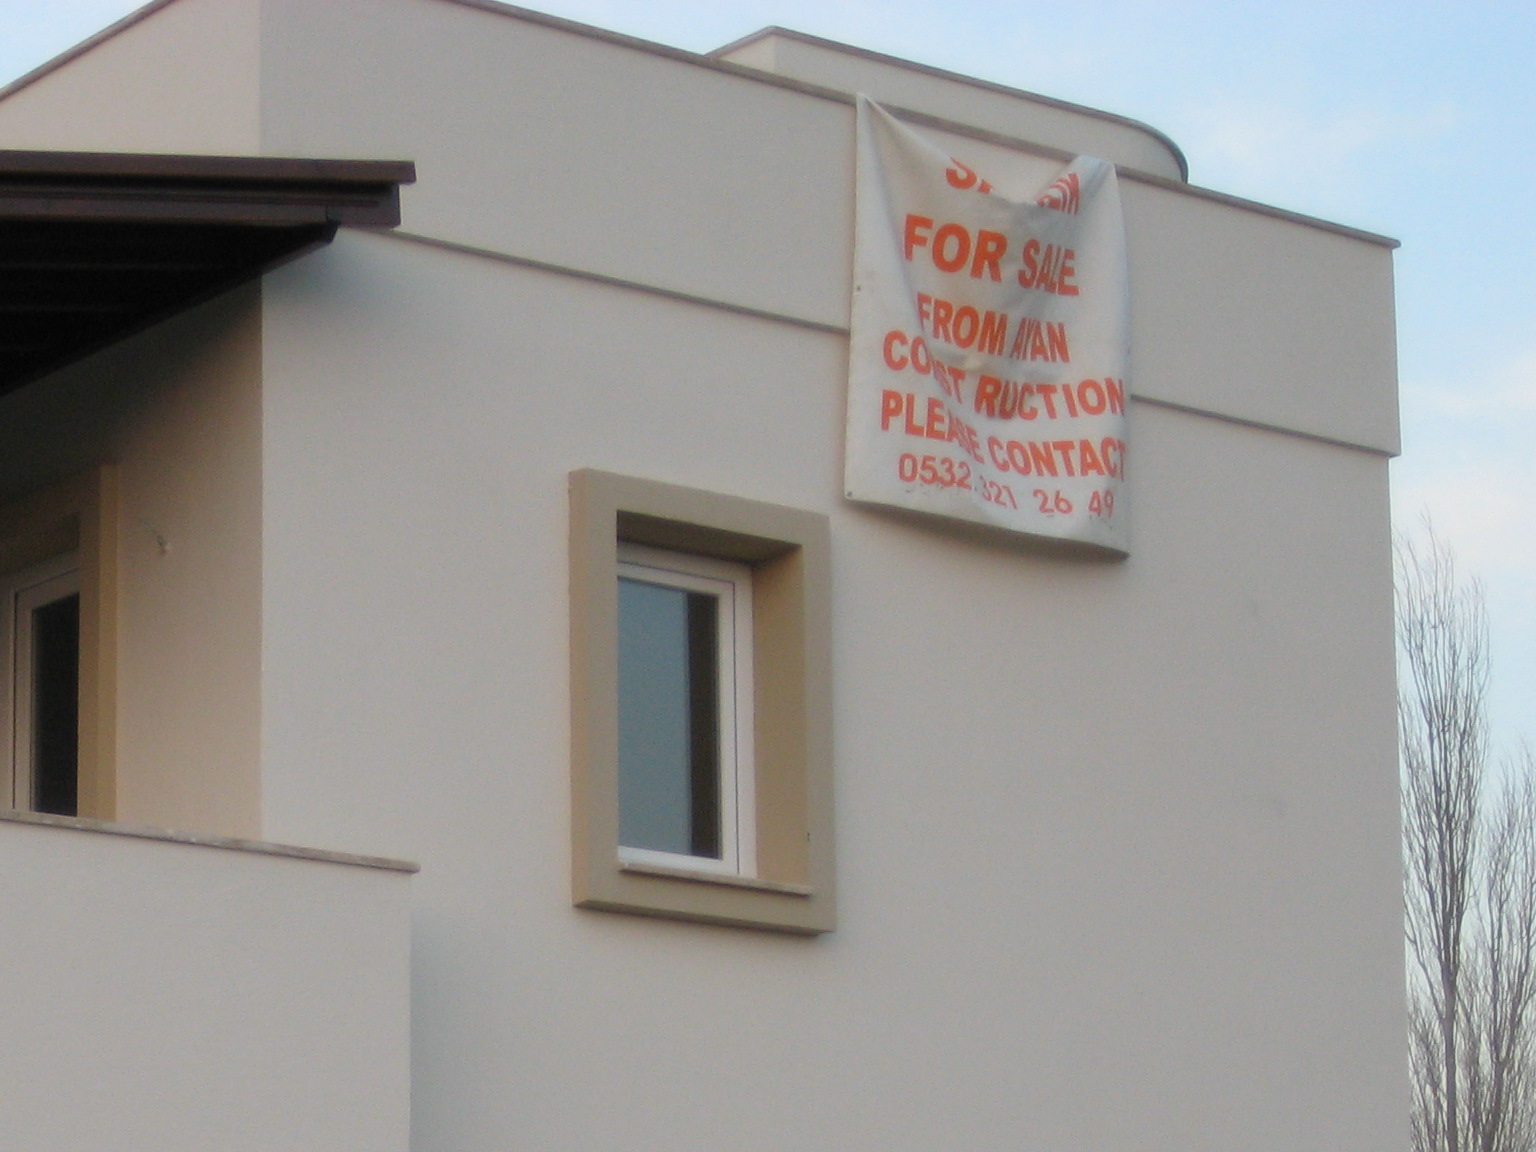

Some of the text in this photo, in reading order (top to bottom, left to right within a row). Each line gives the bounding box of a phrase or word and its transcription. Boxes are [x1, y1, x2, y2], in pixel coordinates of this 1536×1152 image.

[904, 214, 1080, 296] FOR SALE
[916, 292, 1008, 356] FROM
[898, 452, 972, 490] 0532
[1033, 489, 1073, 514] 26
[1088, 490, 1115, 517] 49
[987, 436, 1127, 482] CONTACT
